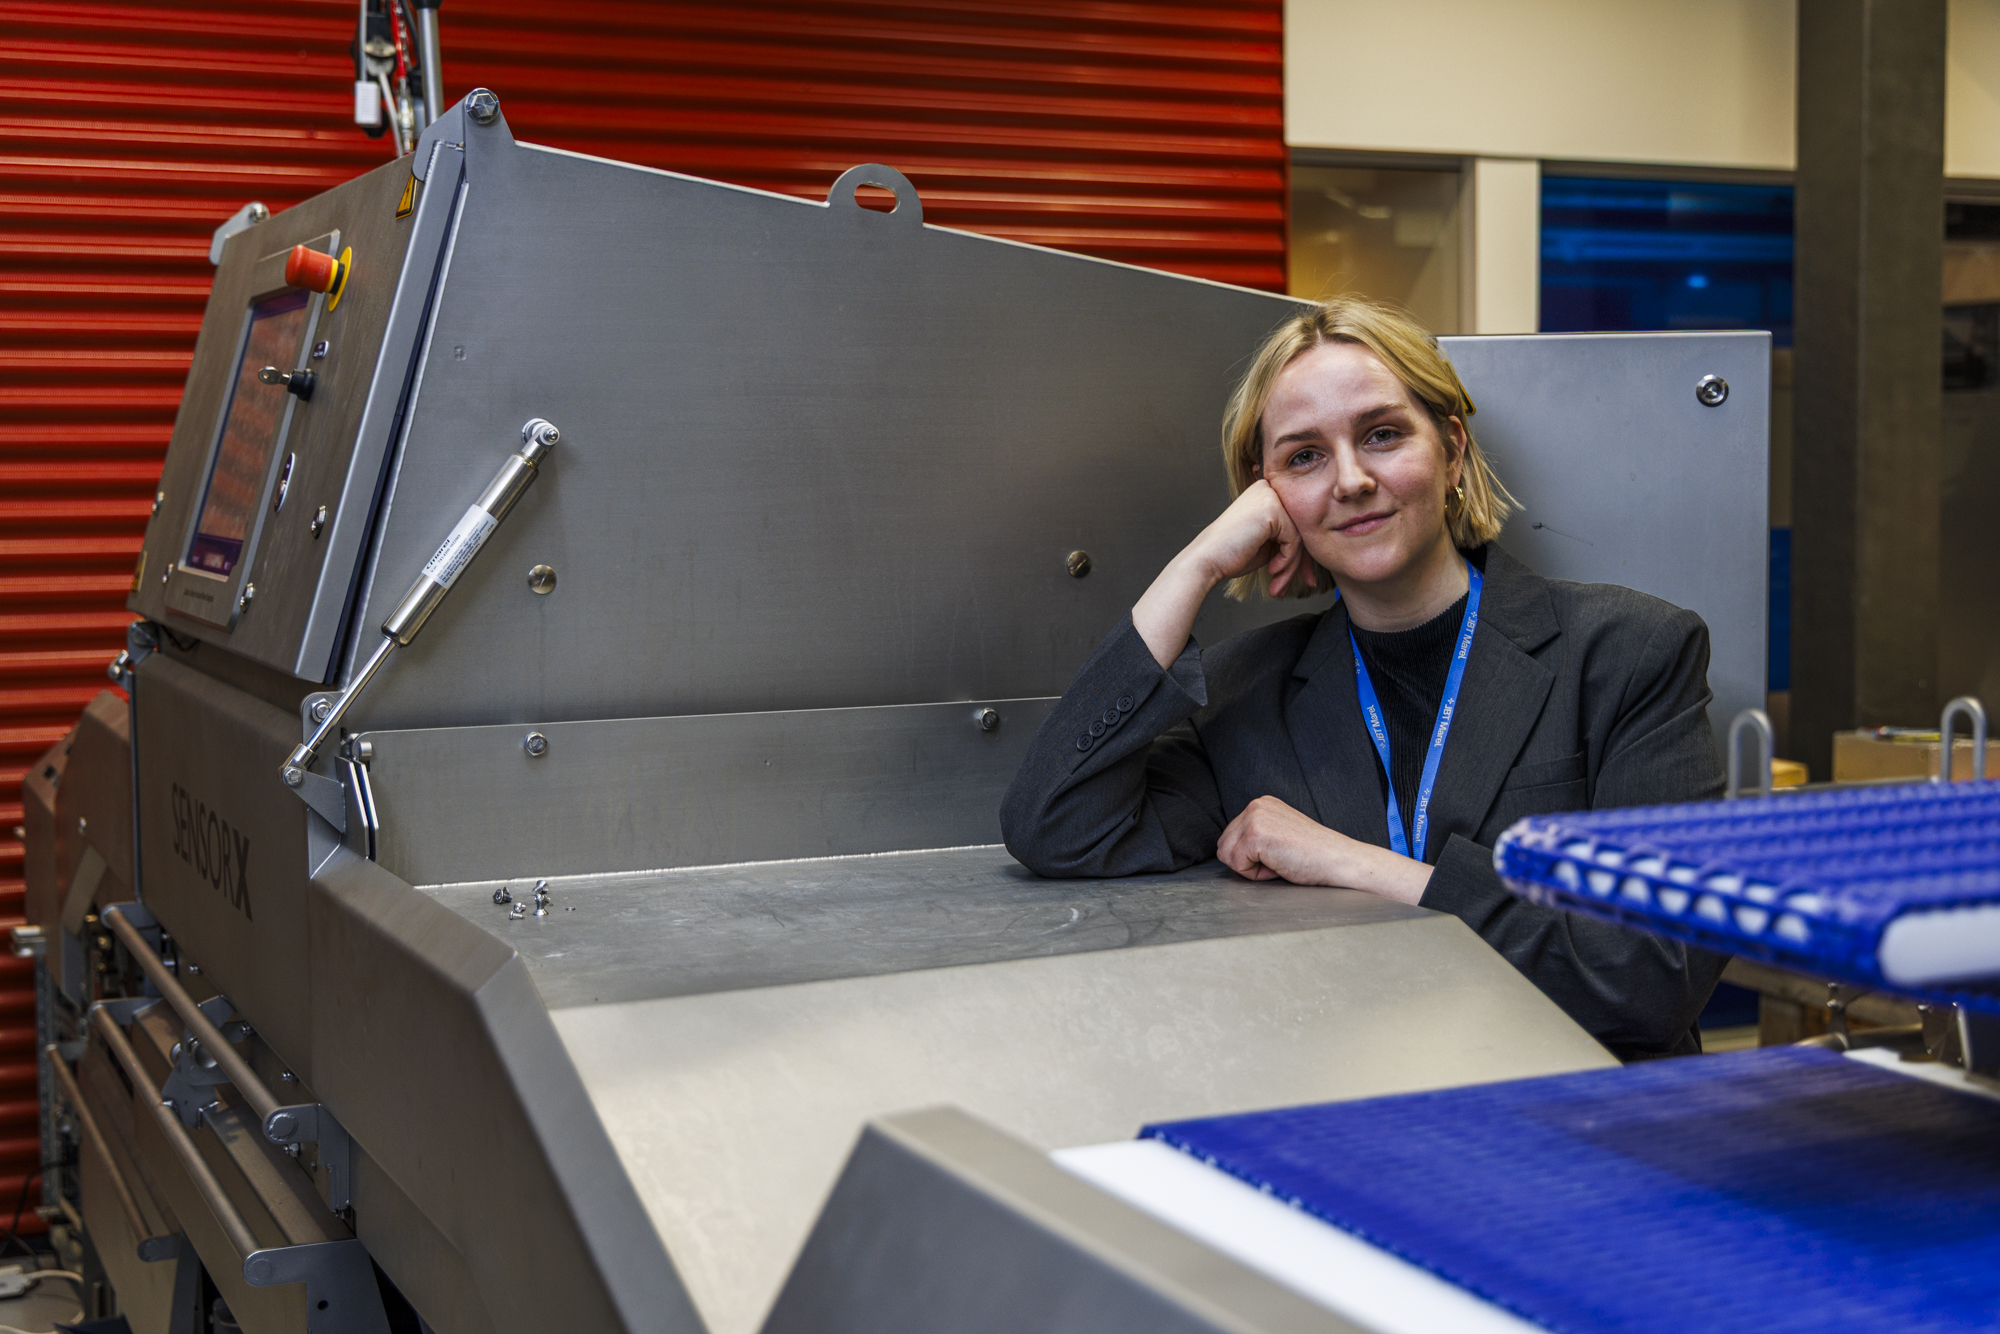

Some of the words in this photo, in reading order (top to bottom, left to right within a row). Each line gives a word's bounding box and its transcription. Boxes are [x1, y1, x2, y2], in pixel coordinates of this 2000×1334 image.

[1465, 616, 1476, 636] JBT
[1458, 634, 1473, 660] Marel
[1366, 704, 1381, 729] Marel
[1442, 703, 1453, 723] JBT
[1373, 727, 1386, 744] JBT
[1434, 720, 1449, 748] Marel
[1418, 795, 1429, 813] JBT
[1414, 813, 1426, 844] Marel
[172, 781, 253, 922] SENSORX
